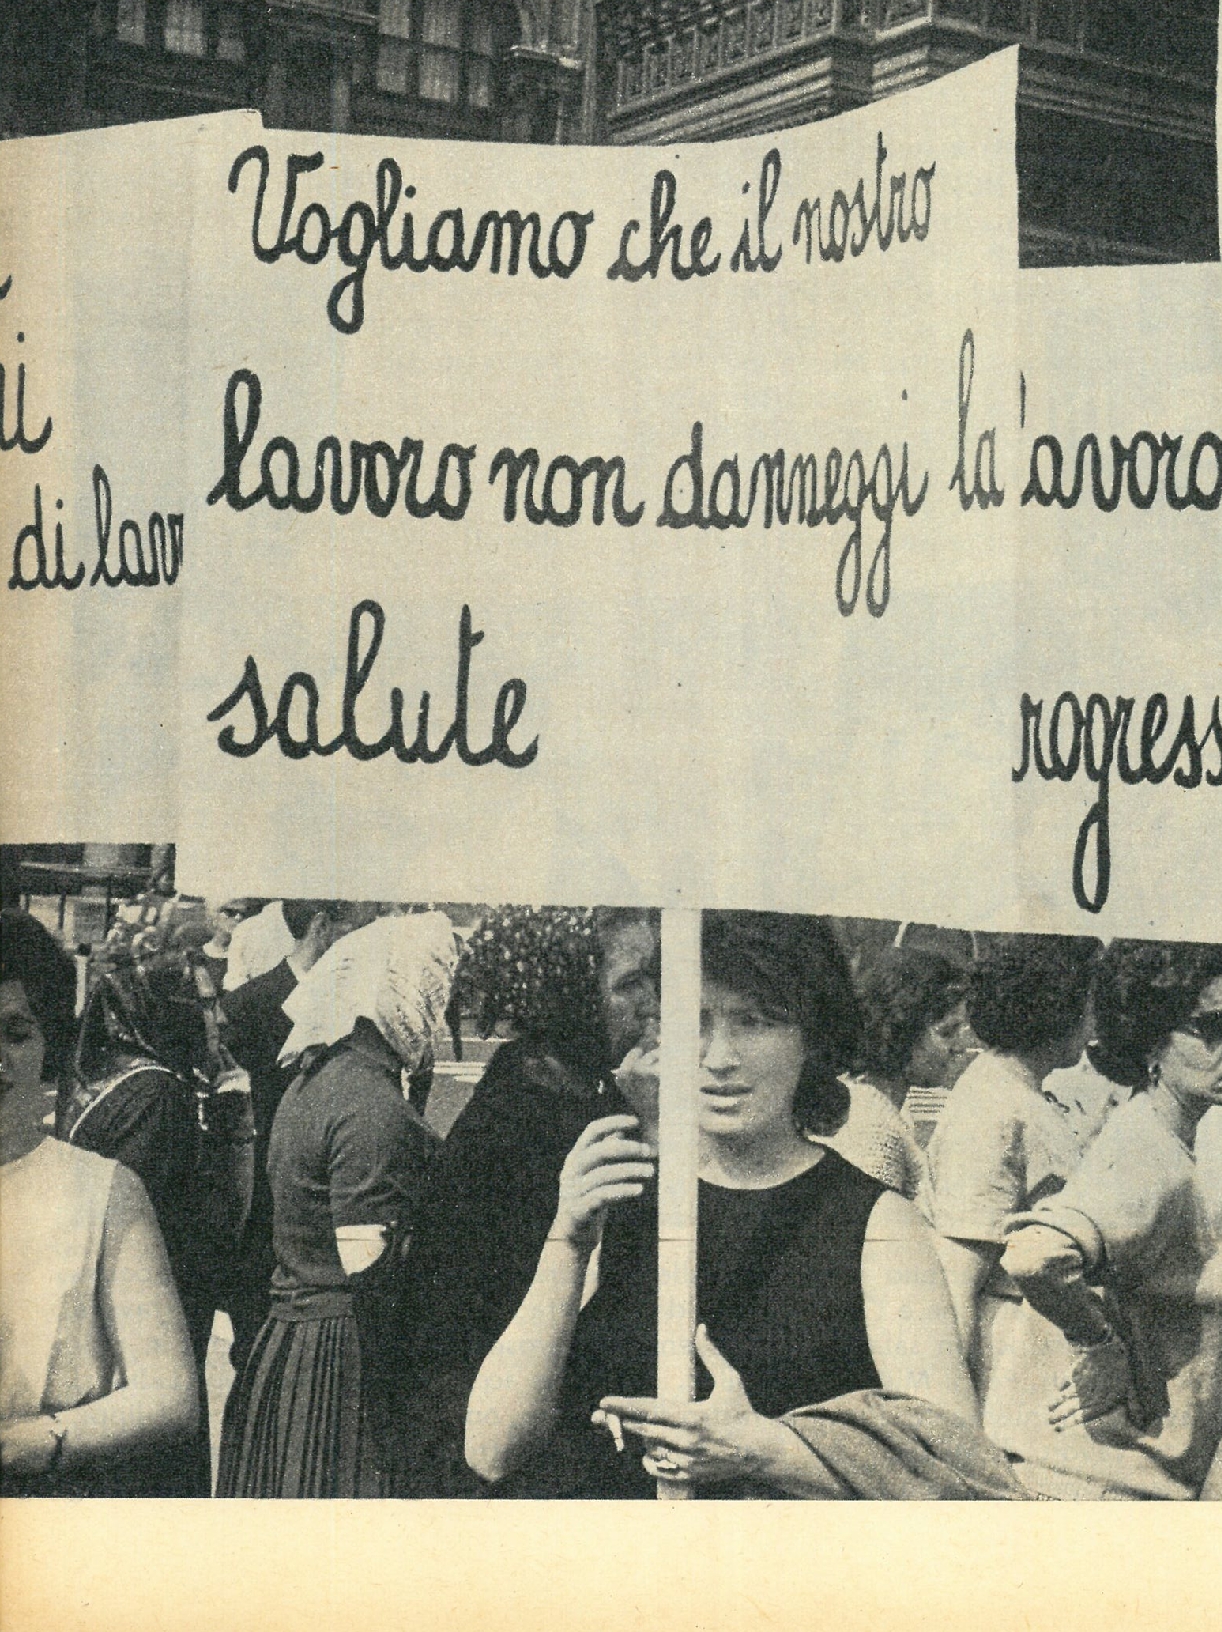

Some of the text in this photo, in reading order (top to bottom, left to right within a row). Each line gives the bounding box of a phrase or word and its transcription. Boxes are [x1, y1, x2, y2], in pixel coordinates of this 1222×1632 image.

[229, 130, 936, 335] Vogliamo che il nostro
[8, 482, 87, 591] di
[205, 328, 1005, 618] lavoro non danneggi la
[206, 598, 539, 769] salute
